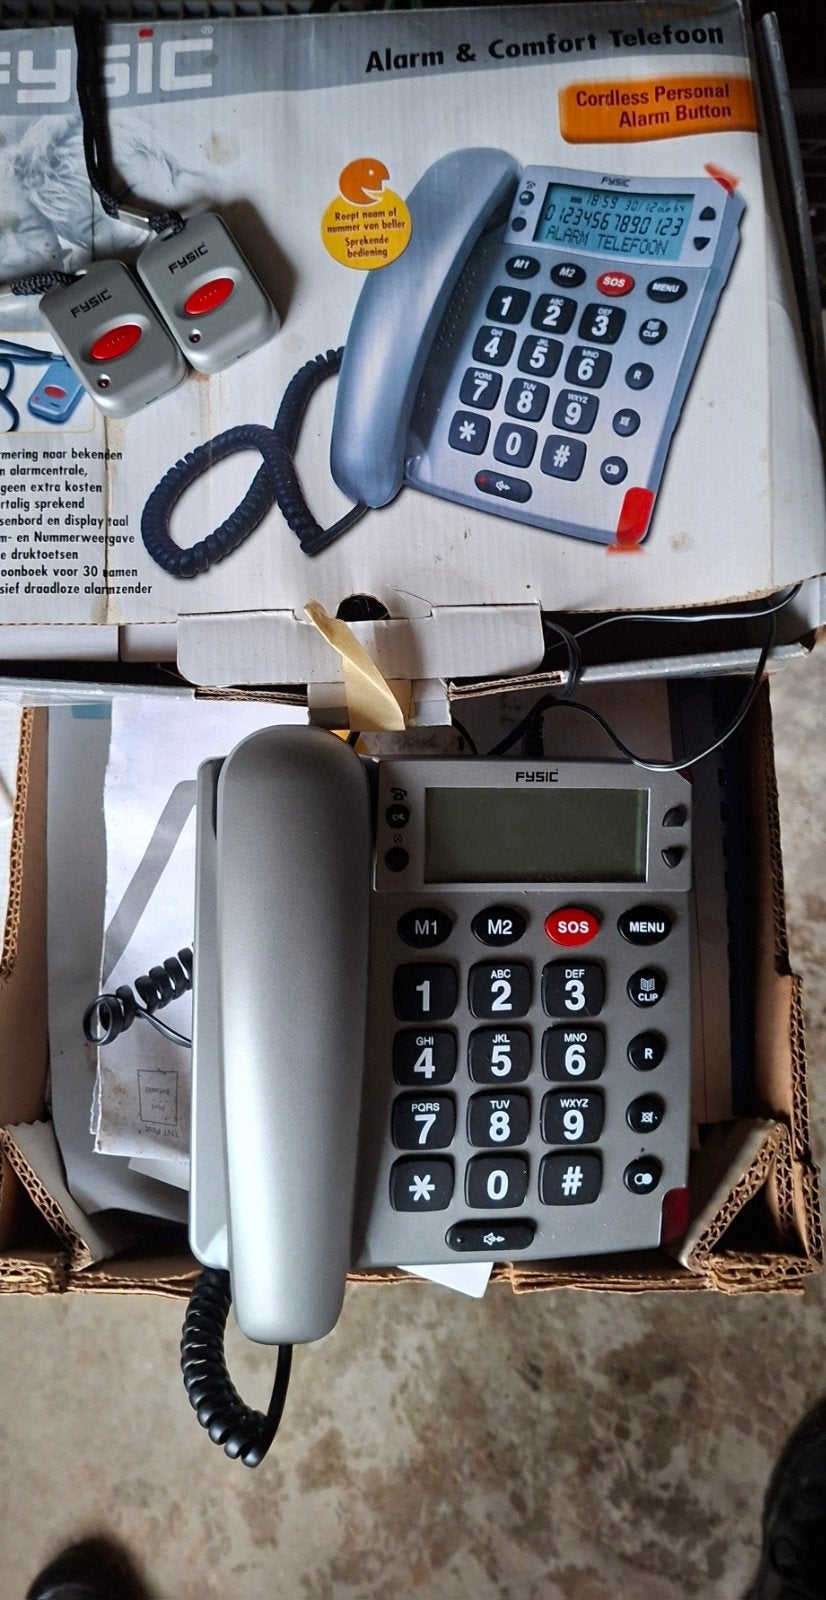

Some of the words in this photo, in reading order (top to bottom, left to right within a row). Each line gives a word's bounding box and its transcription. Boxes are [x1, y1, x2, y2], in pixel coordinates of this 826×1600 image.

[365, 48, 444, 73] Alarm
[456, 43, 476, 63] &
[488, 33, 597, 60] Comfort
[608, 24, 724, 47] Telefoon
[576, 90, 649, 107] Cordless
[655, 83, 730, 102] Personal
[619, 111, 670, 128] Alarm
[676, 104, 732, 121] Button
[587, 195, 619, 210] 18:59
[335, 211, 359, 222] Roept
[362, 211, 385, 219] naam
[388, 207, 397, 217] of
[327, 224, 360, 233] nummer
[382, 219, 405, 229] beller
[345, 235, 389, 248] Sprekende
[546, 225, 590, 247] ALARM
[598, 233, 669, 256] TELEFOON
[347, 247, 388, 258] bediening
[514, 259, 530, 270] M1
[559, 267, 576, 278] M2
[602, 276, 626, 288] SOS
[652, 282, 680, 294] MENU
[501, 295, 513, 317] 1
[598, 307, 613, 315] DEF
[542, 305, 562, 327] 2
[591, 315, 609, 337] 3
[483, 336, 502, 358] 4
[529, 346, 548, 369] 5
[577, 358, 594, 381] 6
[633, 370, 641, 380] R
[472, 379, 488, 402] 7
[523, 382, 537, 391] TUV
[516, 391, 534, 414] 8
[568, 393, 588, 404] WXYZ
[564, 403, 582, 426] 9
[505, 432, 522, 456] 0
[43, 450, 67, 460] naar
[71, 448, 122, 460] bekenden
[553, 444, 570, 468] #
[10, 464, 88, 477] alarmcentrale,
[1, 484, 26, 495] geen
[31, 482, 60, 492] extra
[65, 481, 102, 493] kosten
[0, 498, 30, 511] rtalig
[35, 497, 85, 511] sprekend
[0, 514, 42, 526] senbord
[47, 517, 60, 525] en
[64, 514, 104, 529] display
[108, 515, 129, 527] taal
[17, 534, 30, 543] en
[34, 532, 135, 546] Nummerweergave
[0, 552, 6, 560] e
[11, 548, 78, 560] druktoetsen
[0, 565, 48, 577] oonboek
[53, 568, 78, 577] voor
[83, 566, 98, 577] 30
[103, 568, 137, 577] namen
[24, 582, 80, 594] draadloze
[84, 581, 152, 595] alarmzender
[415, 919, 438, 936] M1
[487, 919, 513, 936] M2
[557, 920, 590, 934] SOS
[629, 921, 665, 933] MENU
[490, 969, 511, 979] ABC
[565, 969, 585, 979] DEF
[416, 980, 431, 1012] 1
[490, 979, 513, 1011] 2
[564, 979, 586, 1011] 3
[637, 993, 659, 1002] CLIP
[416, 1036, 434, 1046] GHI
[492, 1033, 511, 1043] JKL
[564, 1033, 588, 1043] MNO
[564, 1044, 586, 1076] 6
[644, 1048, 653, 1059] R
[413, 1047, 436, 1079] 4
[490, 1045, 512, 1077] 5
[411, 1102, 440, 1113] PQRS
[490, 1100, 510, 1109] TUV
[560, 1099, 589, 1109] WXYZ
[414, 1114, 437, 1145] 7
[489, 1110, 511, 1142] 8
[563, 1109, 584, 1141] 9
[487, 1169, 509, 1200] 0
[561, 1166, 583, 1196] #
